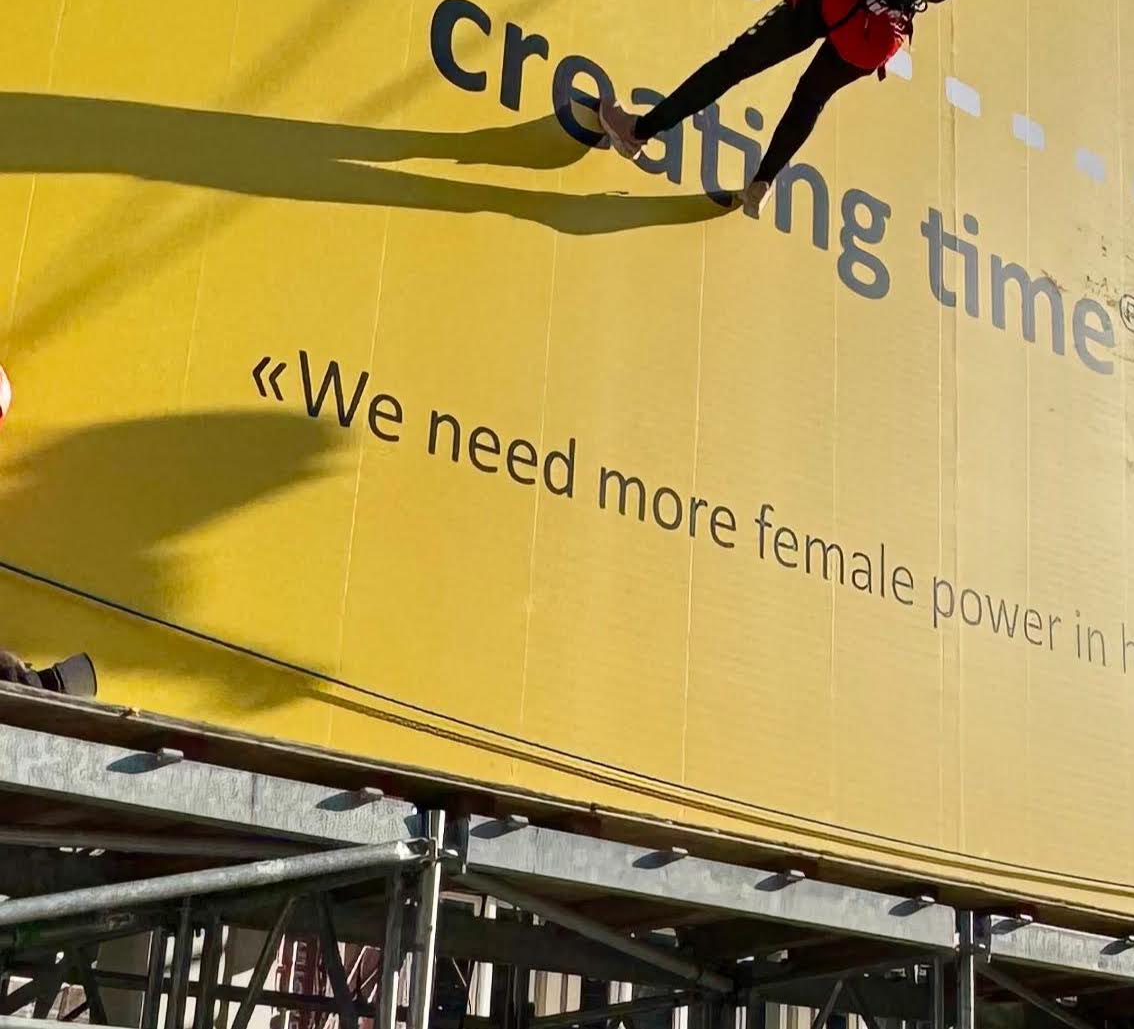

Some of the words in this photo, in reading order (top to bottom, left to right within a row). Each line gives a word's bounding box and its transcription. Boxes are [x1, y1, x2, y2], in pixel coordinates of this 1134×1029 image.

[427, 409, 577, 498] need
[598, 466, 737, 548] more
[754, 503, 915, 606] female
[932, 575, 1062, 652] power
[1075, 609, 1107, 667] in
